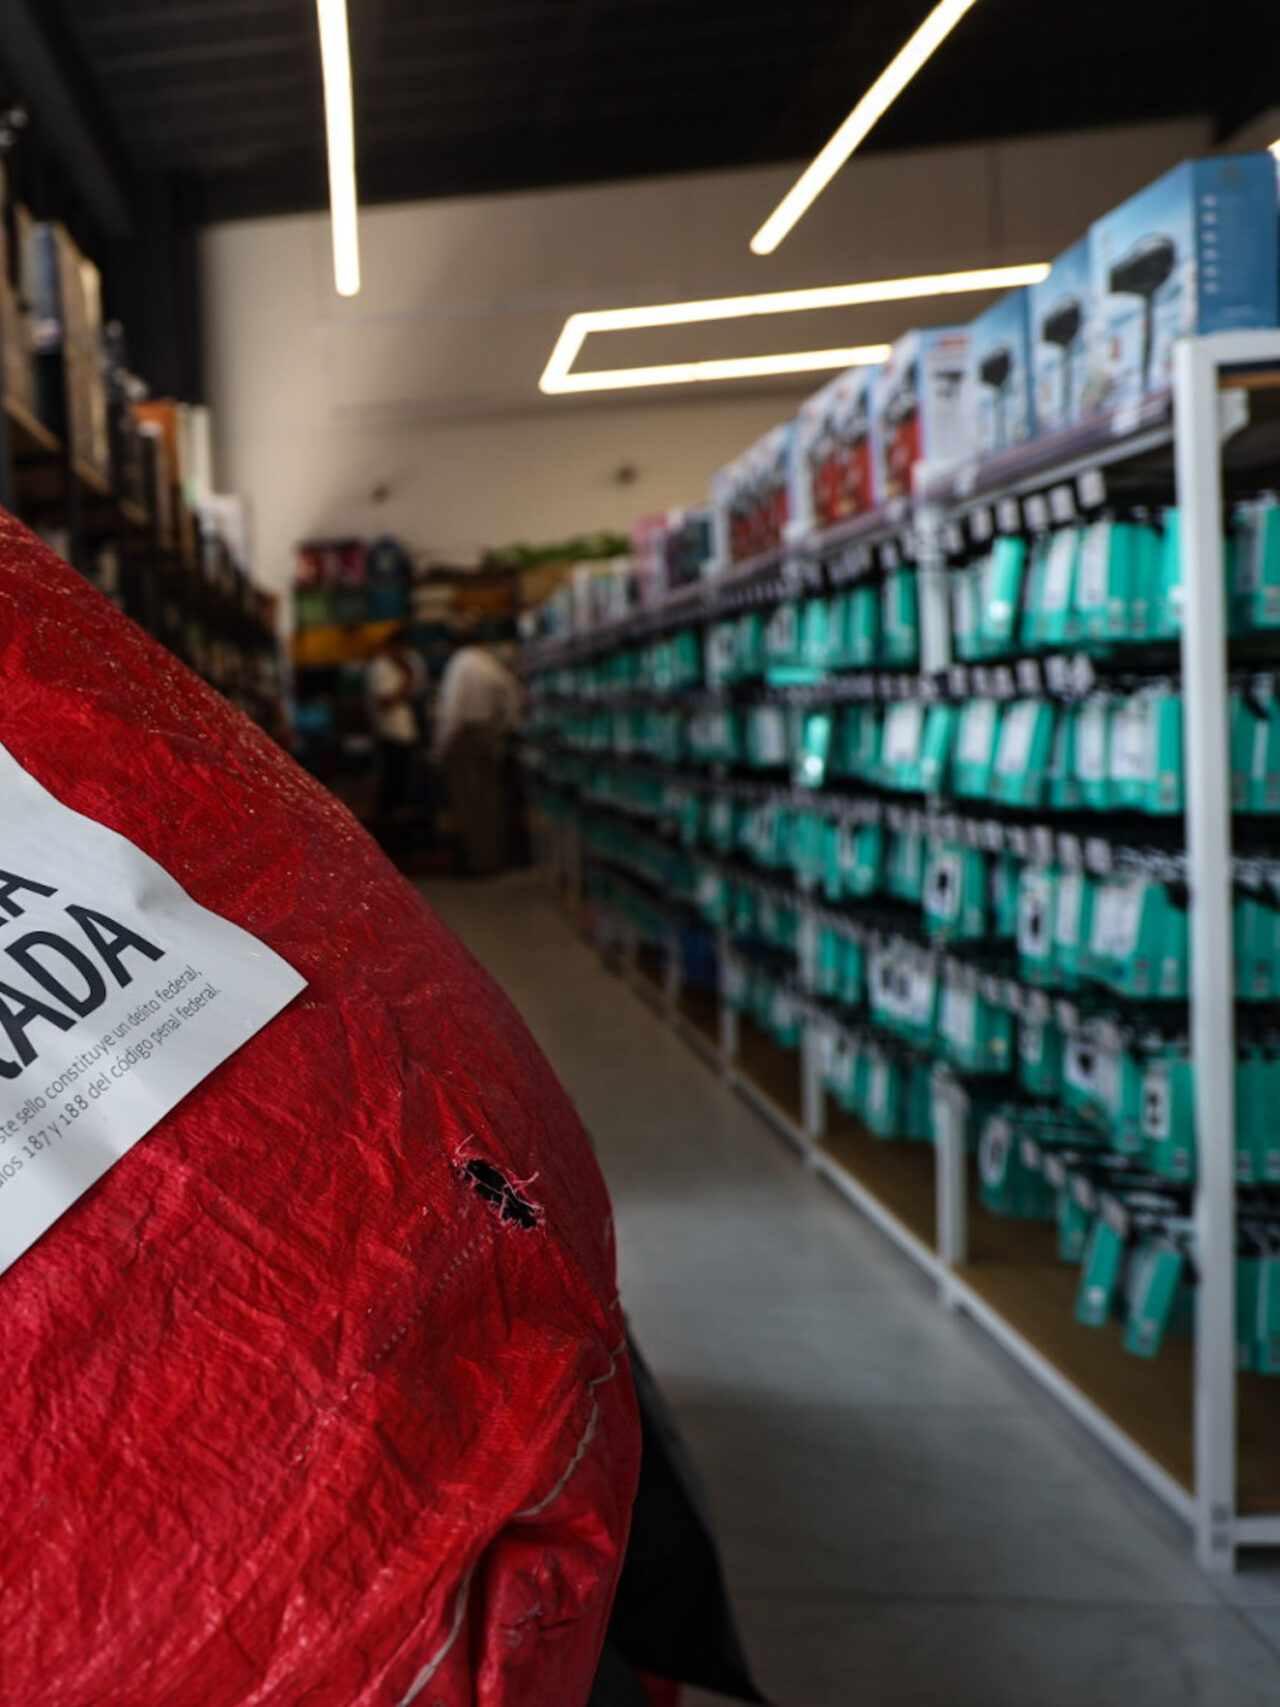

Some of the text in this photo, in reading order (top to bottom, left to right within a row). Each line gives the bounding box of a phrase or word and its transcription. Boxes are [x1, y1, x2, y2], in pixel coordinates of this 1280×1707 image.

[15, 1093, 47, 1125] sello
[45, 1032, 116, 1099] constituye
[111, 1022, 131, 1039] un
[127, 998, 160, 1027] delito
[156, 964, 203, 1003] federal,
[22, 1127, 53, 1158] 187
[47, 1121, 64, 1138] y
[62, 1094, 88, 1126] 188
[88, 1073, 112, 1099] del
[151, 1016, 182, 1047] penal
